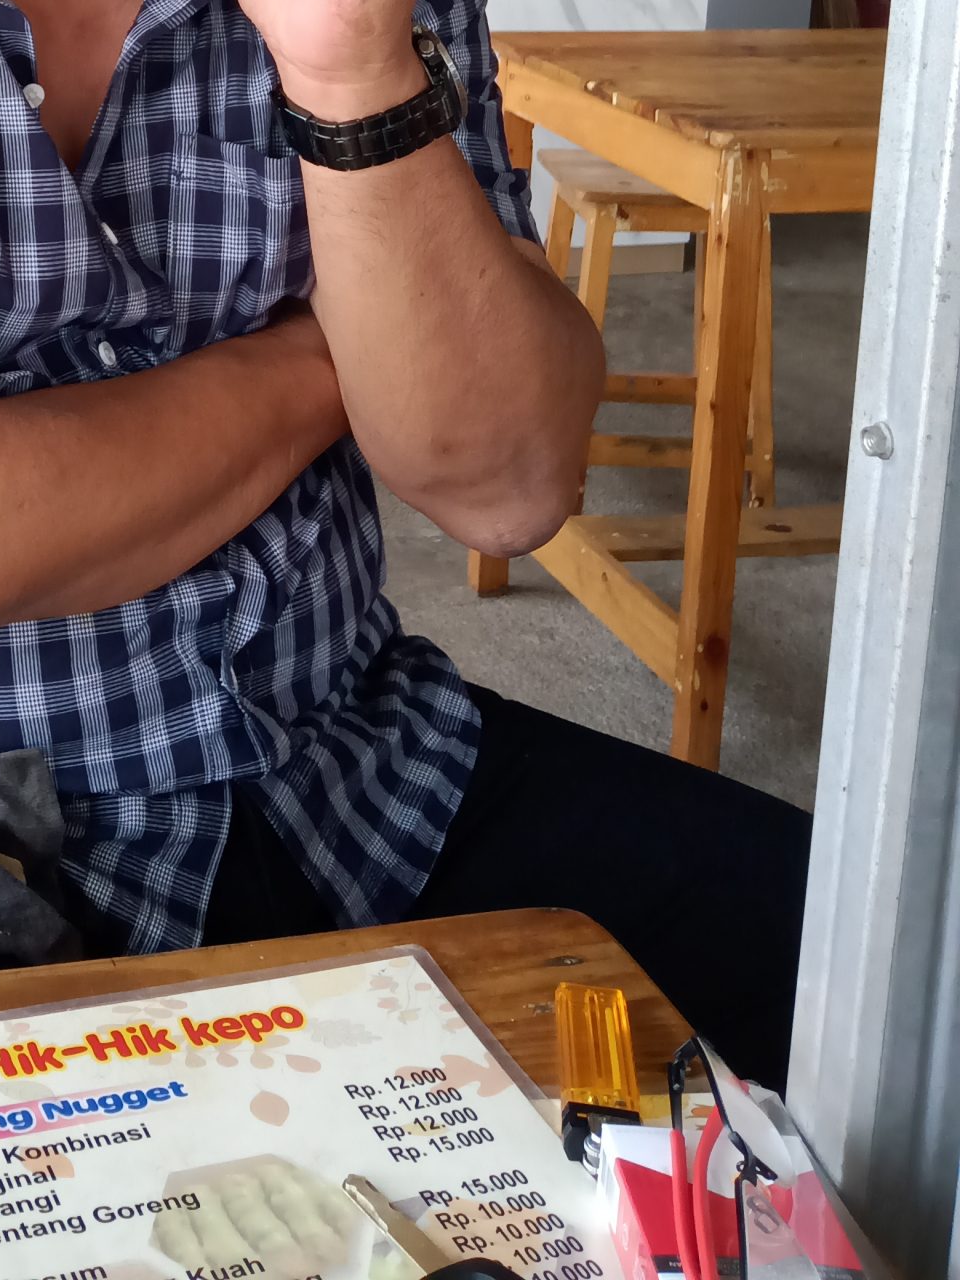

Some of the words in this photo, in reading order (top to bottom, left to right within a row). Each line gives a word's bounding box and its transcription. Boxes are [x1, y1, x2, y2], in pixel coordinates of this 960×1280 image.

[181, 1004, 306, 1048] kepo
[43, 1081, 188, 1122] Nugget
[344, 1083, 382, 1101] Rp.
[384, 1067, 447, 1092] 12.000
[358, 1104, 396, 1121] Rp.
[398, 1087, 463, 1112] 12.000
[372, 1125, 411, 1142] Rp.
[413, 1107, 478, 1133] 12.000
[3, 1123, 151, 1164] Kombinasi
[387, 1145, 427, 1163] Rp.
[429, 1127, 495, 1153] 15.000
[419, 1190, 459, 1208] Rp.
[461, 1169, 529, 1197] 15.000
[93, 1191, 201, 1224] Goreng
[435, 1212, 476, 1231] Rp.
[478, 1191, 546, 1219] 10.000
[452, 1235, 494, 1253] Rp.
[496, 1213, 565, 1242] 10.000
[513, 1236, 584, 1265] 10.000
[186, 1257, 266, 1280] Kuah
